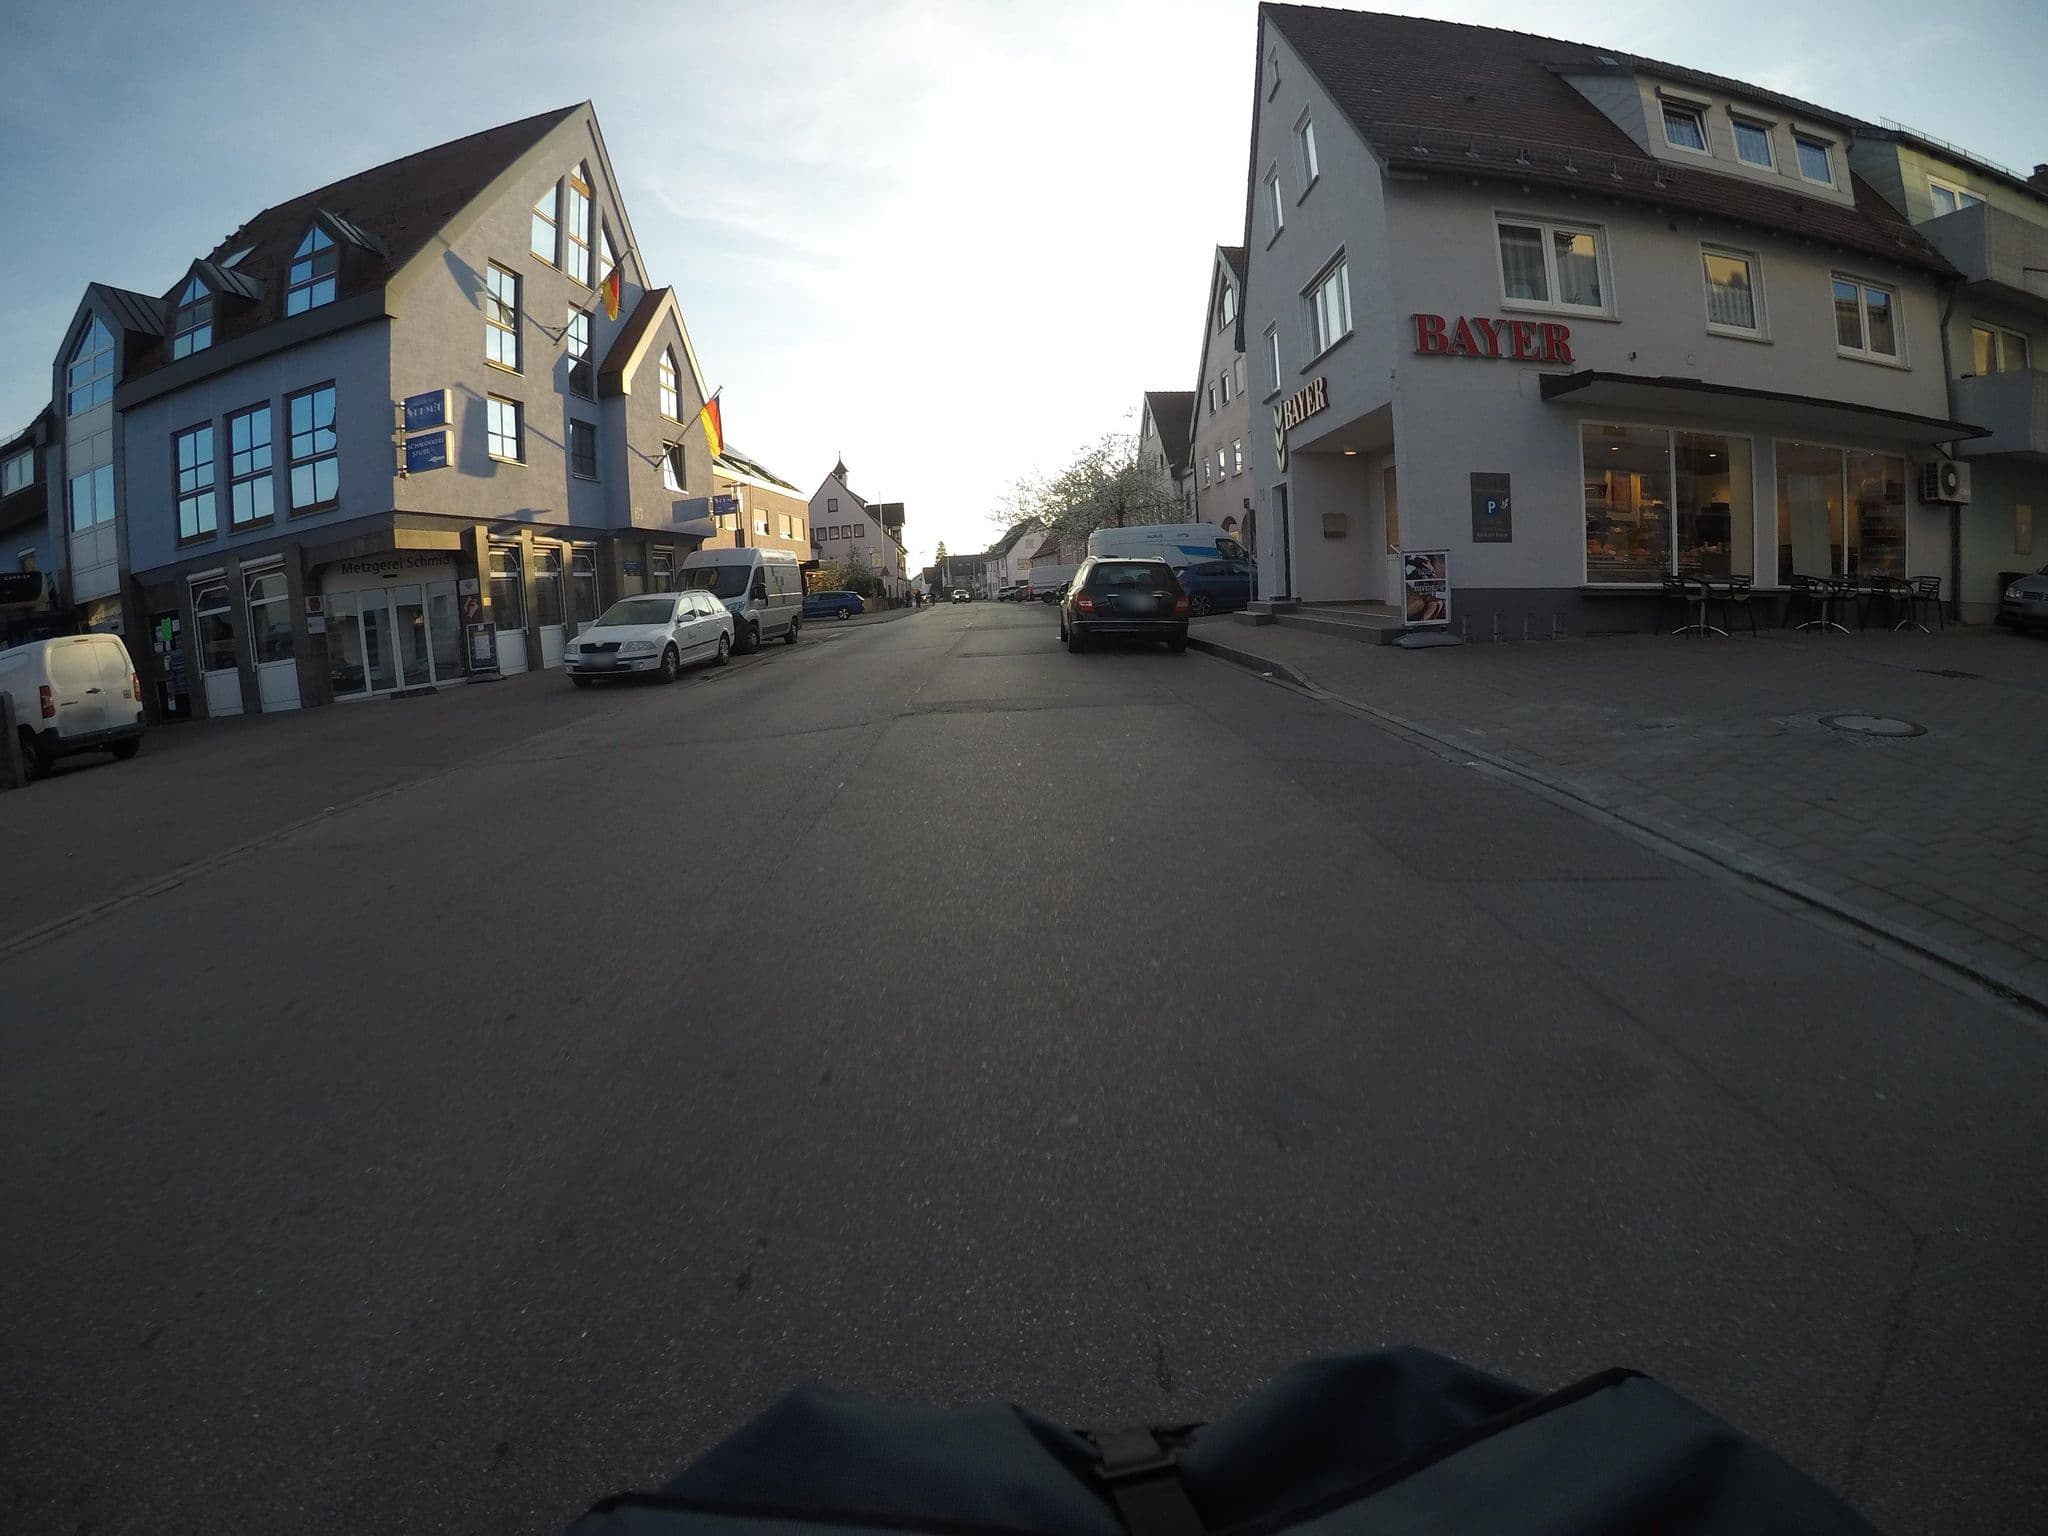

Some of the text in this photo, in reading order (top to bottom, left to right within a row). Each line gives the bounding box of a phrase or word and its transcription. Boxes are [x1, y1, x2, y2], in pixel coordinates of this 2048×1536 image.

[1411, 313, 1577, 364] BAYER
[1282, 376, 1328, 431] BAYER
[1488, 501, 1496, 514] P
[341, 553, 450, 574] Metzgerei Schmid
